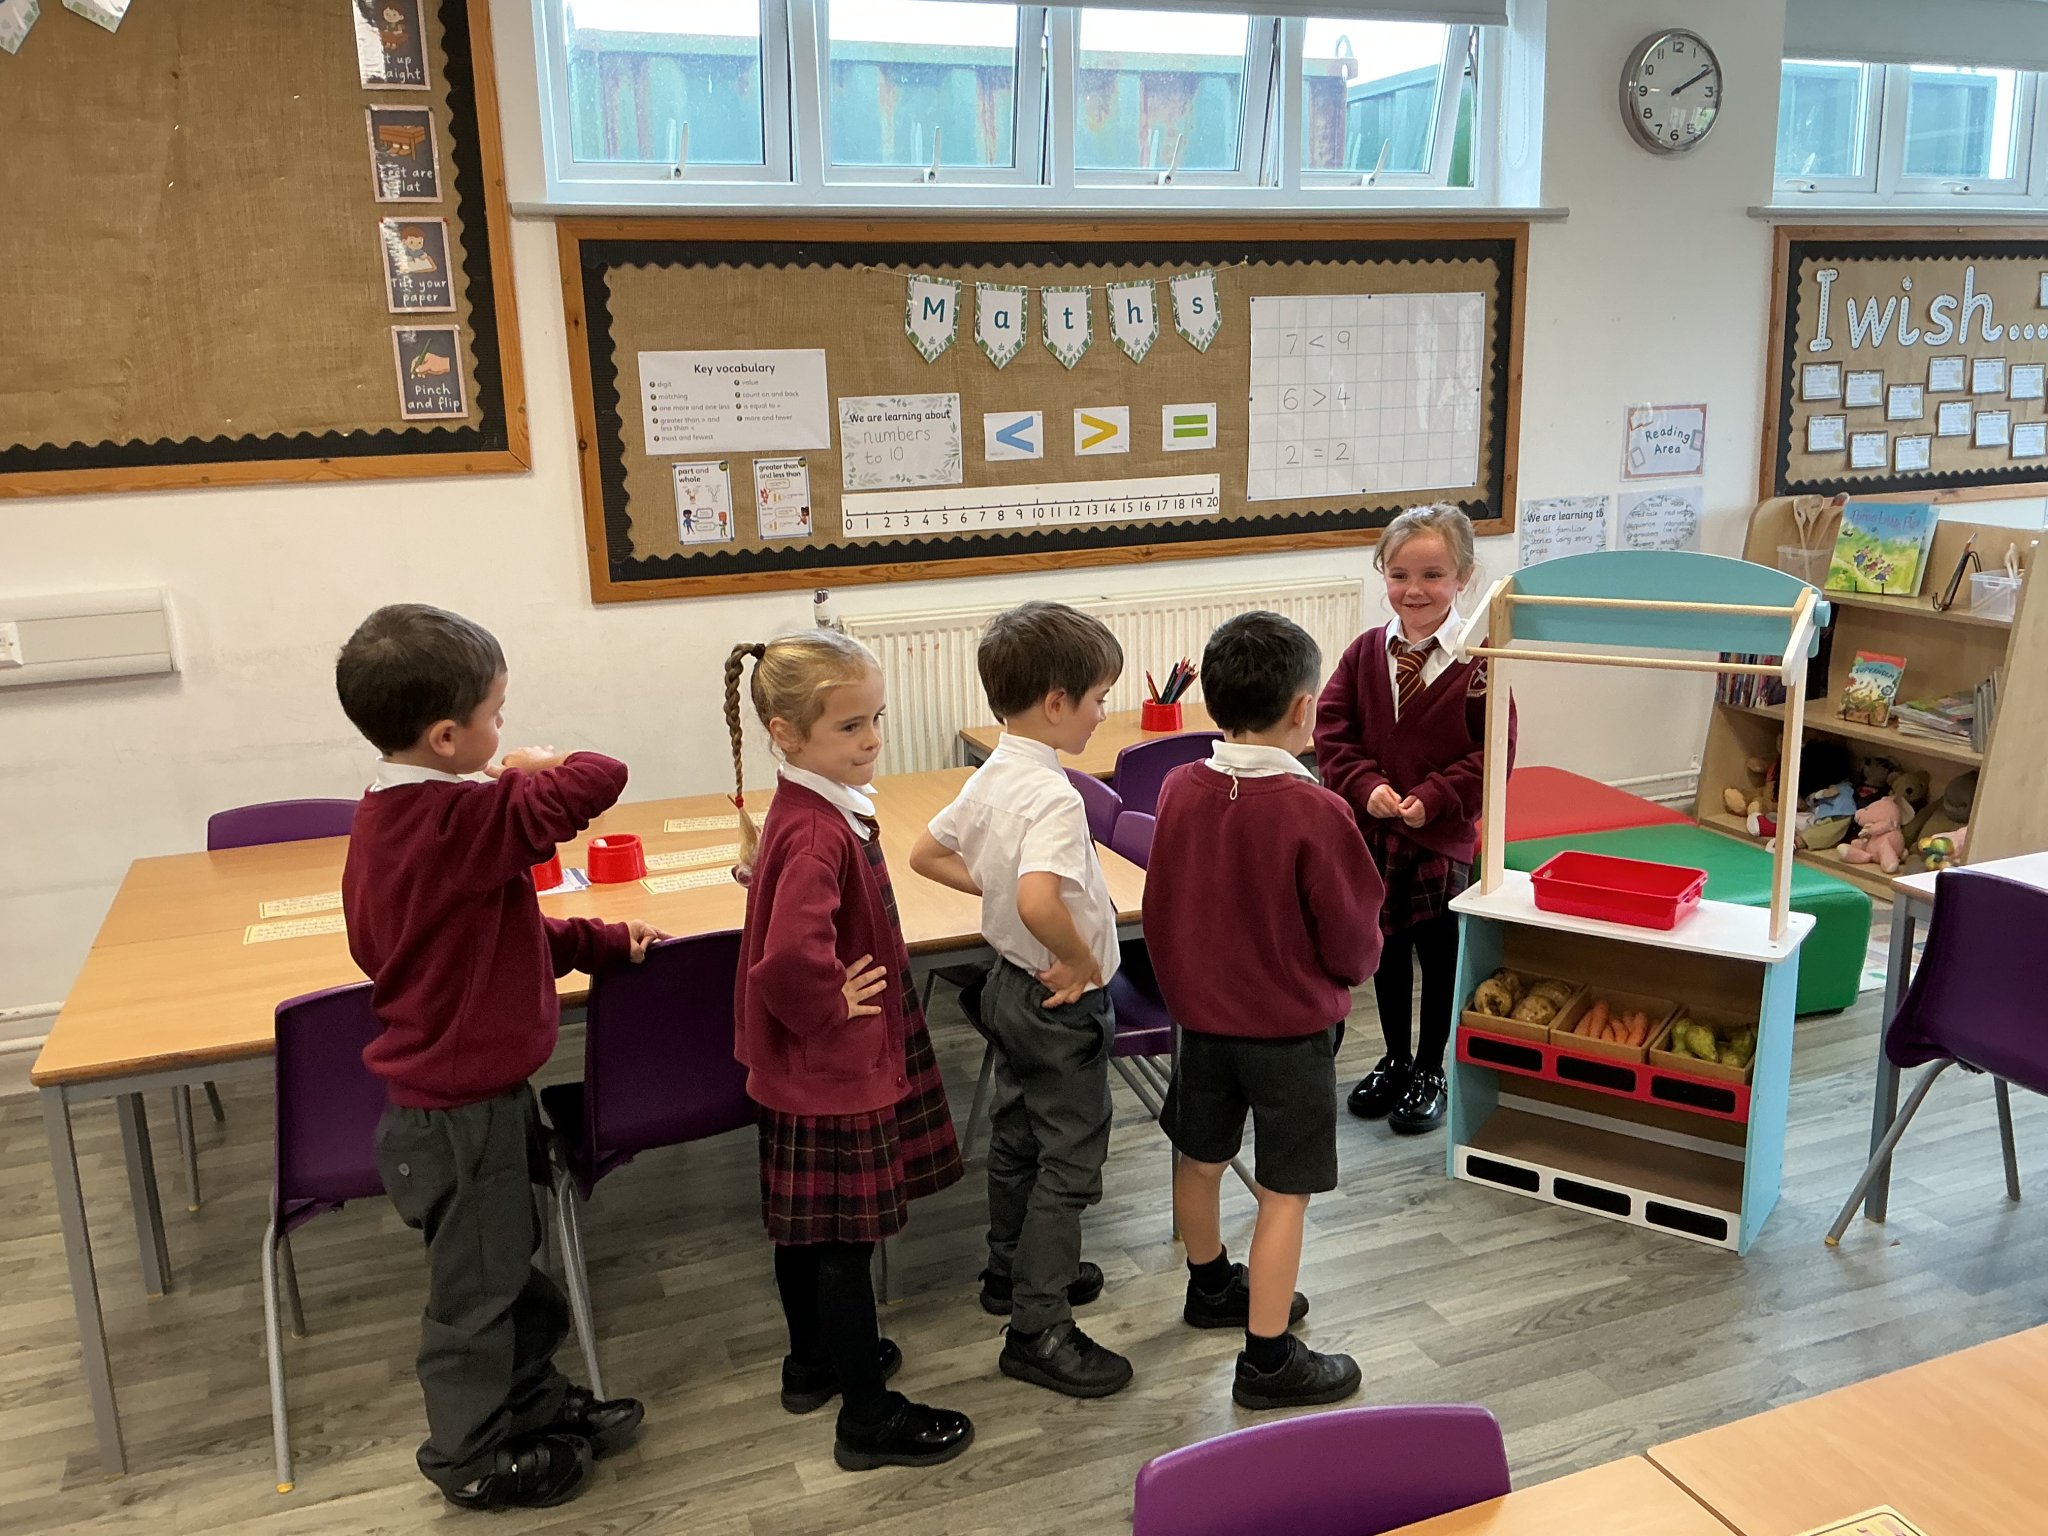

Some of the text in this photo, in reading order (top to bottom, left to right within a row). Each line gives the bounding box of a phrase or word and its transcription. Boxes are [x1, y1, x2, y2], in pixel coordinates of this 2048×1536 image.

[1673, 41, 1684, 53] 12
[1657, 48, 1665, 60] 11
[396, 56, 412, 70] up
[1645, 64, 1655, 76] 10
[1639, 85, 1648, 97] 9
[1704, 86, 1714, 98] 3
[1643, 107, 1653, 119] 8
[1654, 123, 1663, 135] 7
[1670, 129, 1679, 141] 6
[1686, 123, 1696, 135] 5
[412, 168, 433, 179] are
[418, 280, 448, 294] your
[402, 293, 440, 307] paper
[1809, 268, 1839, 352] I
[1286, 333, 1299, 355] 7
[1336, 329, 1351, 351] 9
[693, 362, 776, 377] Key vocabulary
[414, 384, 452, 396] Pinch
[658, 393, 688, 401] matching
[1283, 388, 1299, 411] 6
[1336, 386, 1351, 406] 4
[407, 395, 460, 413] and flip
[849, 409, 951, 423] We are learning about
[863, 425, 932, 445] numbers
[1644, 426, 1692, 445] Reading
[864, 445, 904, 465] to 10
[1284, 445, 1300, 465] 2
[1335, 442, 1350, 461] 2
[1654, 443, 1681, 456] Area
[678, 466, 710, 477] part and
[758, 462, 799, 473] greater than
[678, 475, 701, 484] whole
[759, 472, 772, 480] and
[786, 469, 801, 478] than
[845, 518, 853, 531] 0
[883, 516, 892, 529] 2
[903, 515, 911, 527] 3
[922, 514, 930, 526] 4
[941, 513, 949, 525] 5
[960, 512, 968, 524] 6
[979, 510, 987, 523] 7
[997, 510, 1005, 521] 8
[1016, 508, 1023, 520] 9
[1032, 507, 1045, 519] 10
[1050, 506, 1061, 518] 11
[1069, 505, 1081, 517] 12
[1087, 504, 1099, 515] 13
[1104, 503, 1116, 515] 14
[1122, 501, 1134, 513] 15
[1139, 500, 1151, 512] 16
[1156, 499, 1169, 511] 17
[1174, 498, 1185, 510] 18
[1191, 497, 1202, 509] 19
[1206, 496, 1219, 508] 20
[1527, 509, 1604, 523] We are learning to
[1555, 523, 1587, 537] familiar
